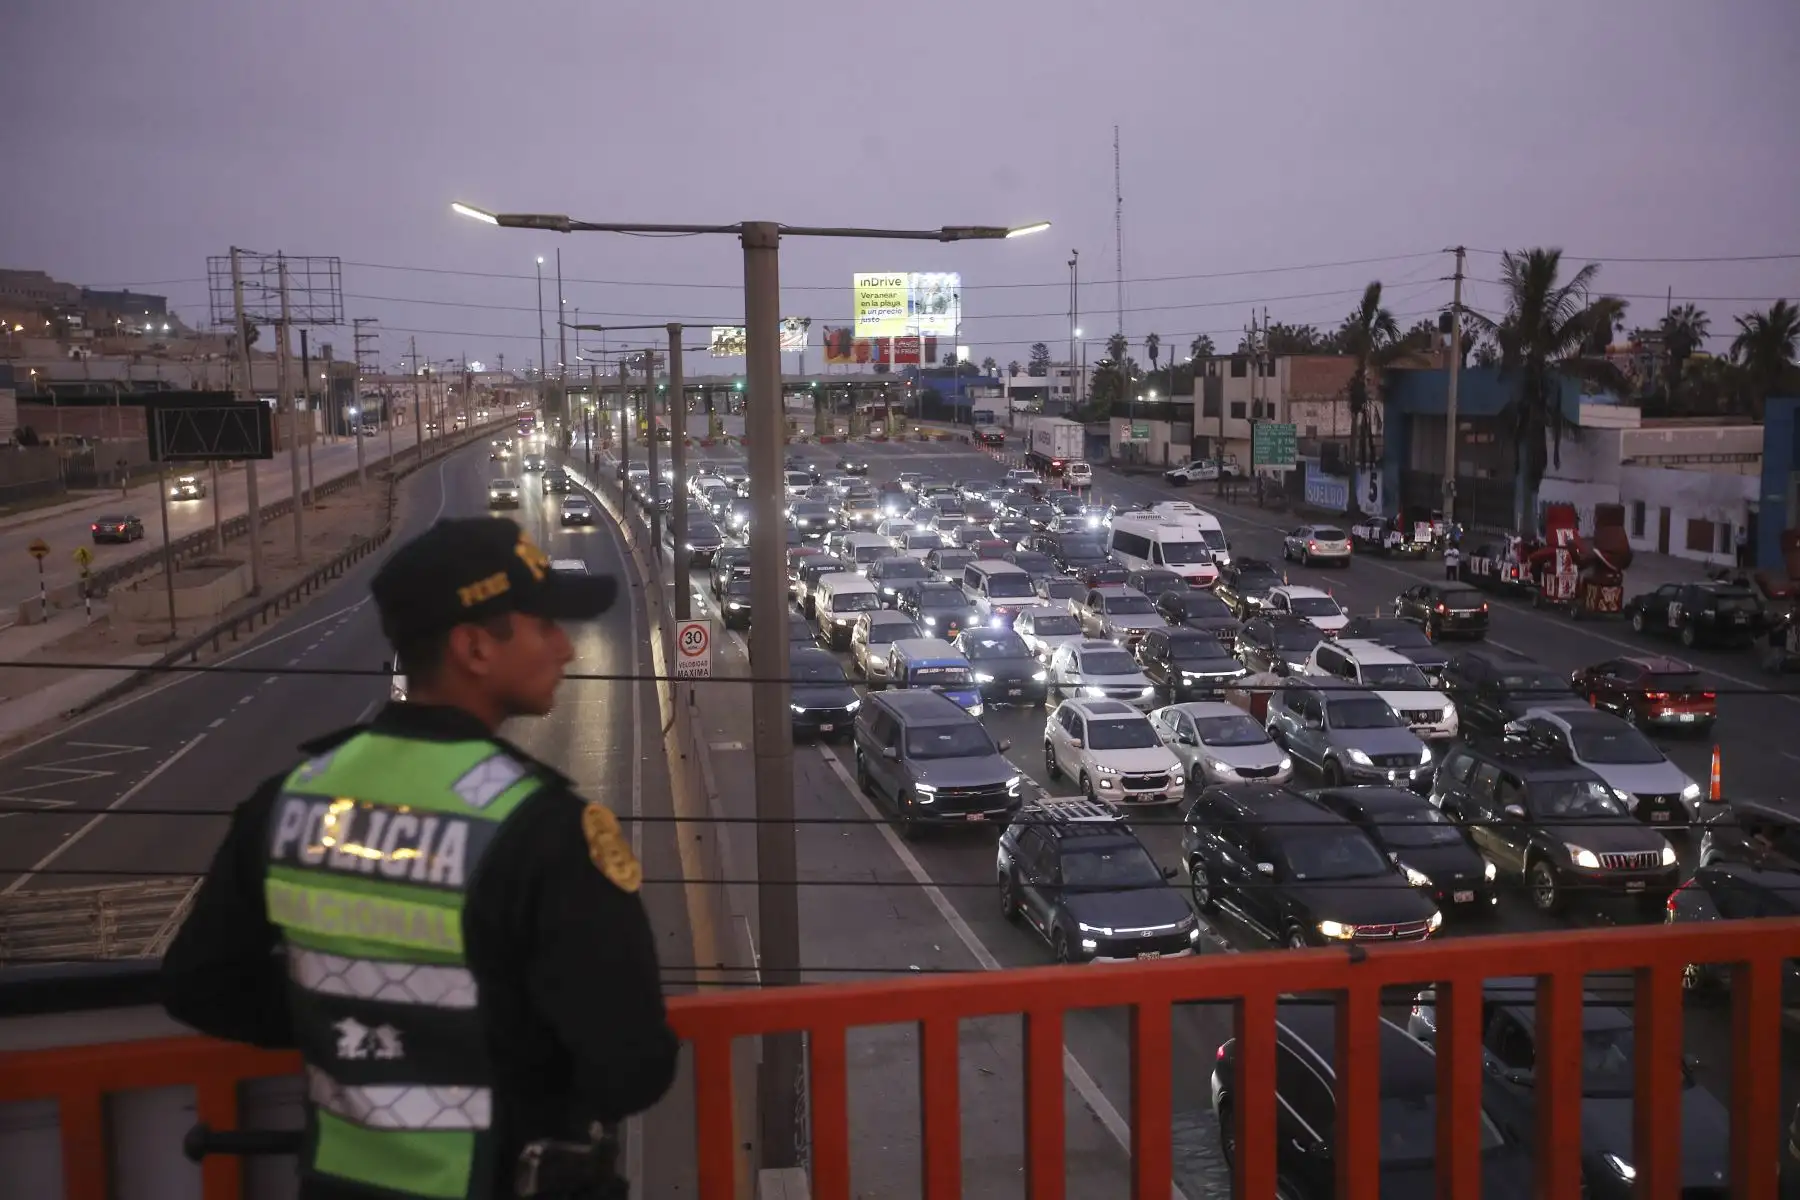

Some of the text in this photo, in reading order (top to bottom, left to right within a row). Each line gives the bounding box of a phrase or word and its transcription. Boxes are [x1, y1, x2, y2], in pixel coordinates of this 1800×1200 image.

[861, 277, 902, 286] inDrive
[880, 300, 901, 308] playa
[878, 307, 902, 316] precio
[860, 316, 880, 325] justo
[1308, 484, 1343, 506] SUELDO
[685, 631, 702, 645] 30
[678, 668, 709, 678] MAXIMA
[272, 798, 469, 886] POLICIA
[272, 885, 455, 946] NACIONAL
